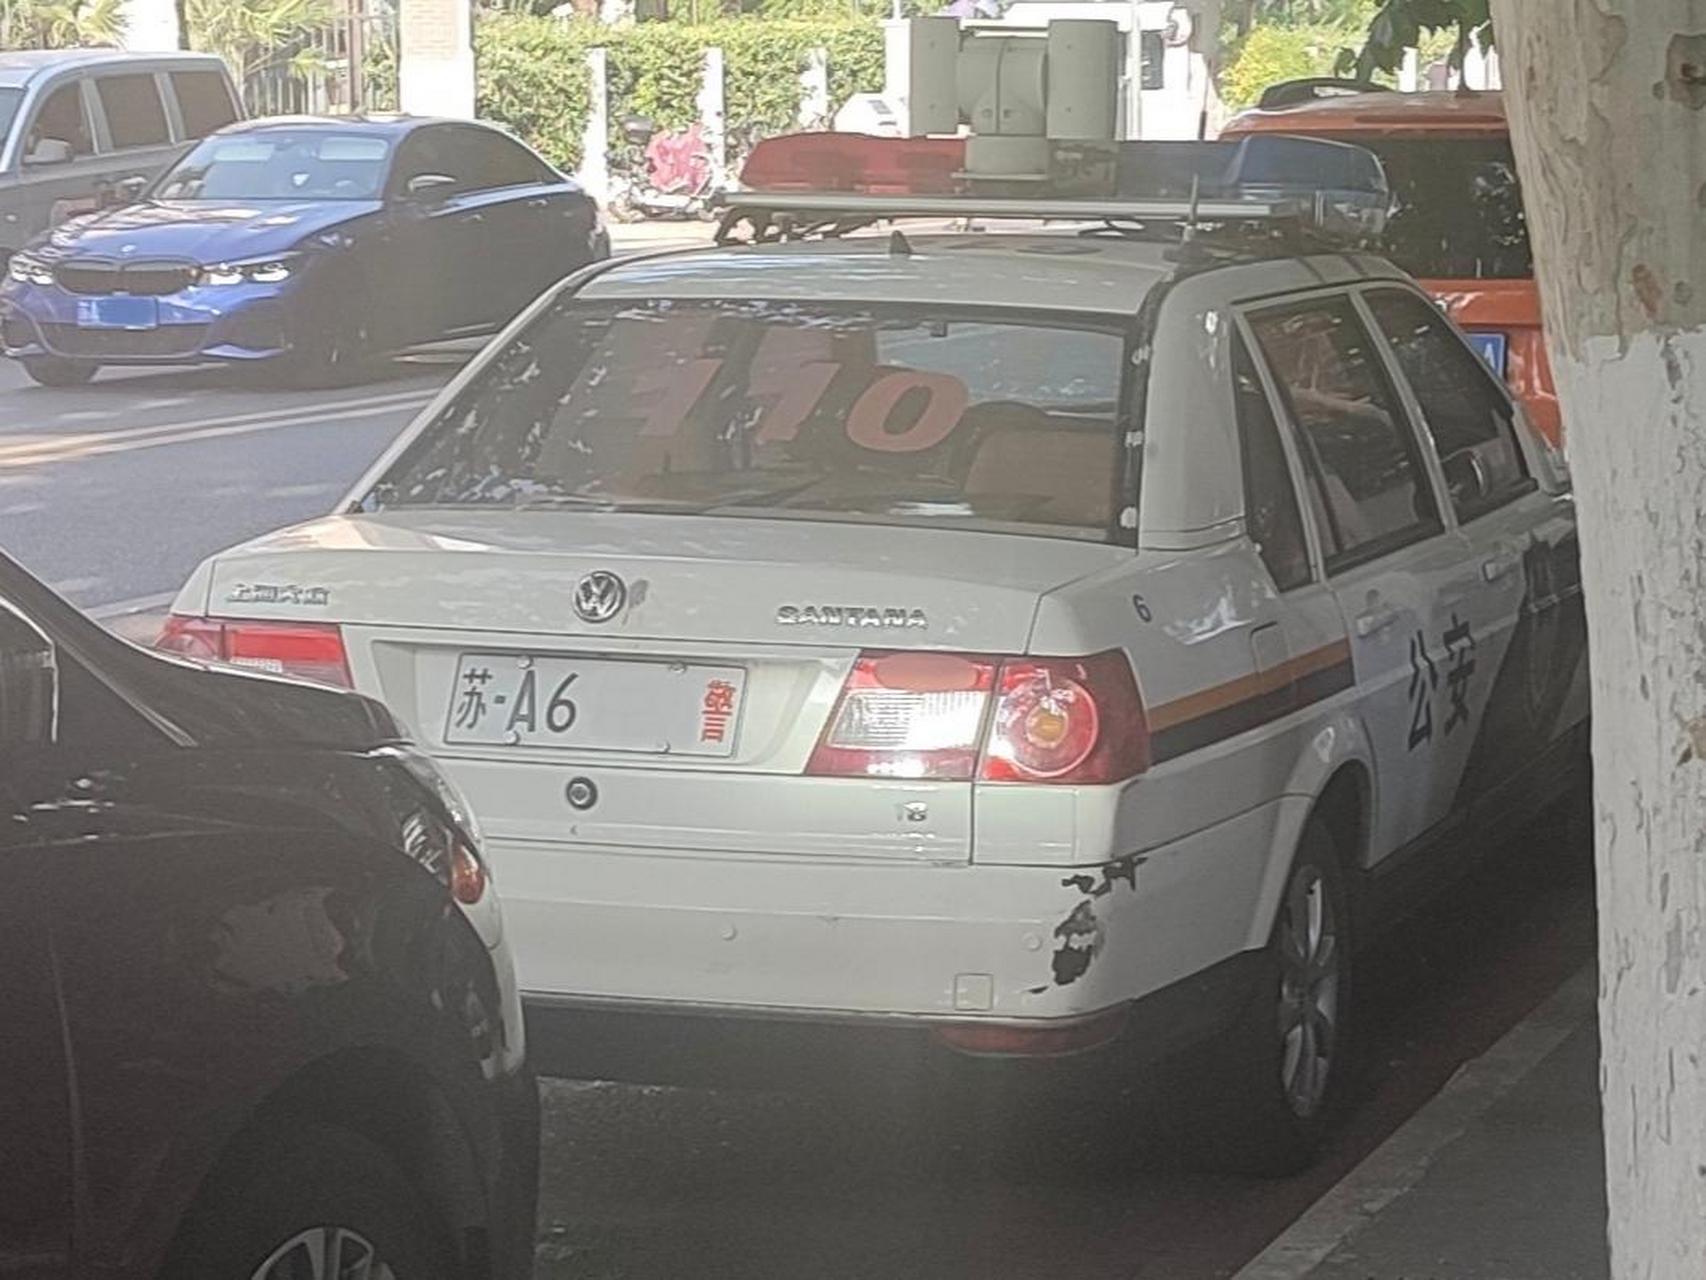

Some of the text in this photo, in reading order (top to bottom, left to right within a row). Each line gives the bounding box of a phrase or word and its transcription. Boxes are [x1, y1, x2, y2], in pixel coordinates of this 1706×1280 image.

[630, 358, 970, 452] 110
[777, 605, 929, 630] SANTANA
[1132, 594, 1152, 622] 6
[701, 679, 736, 742] 警
[1408, 612, 1477, 751] 公安
